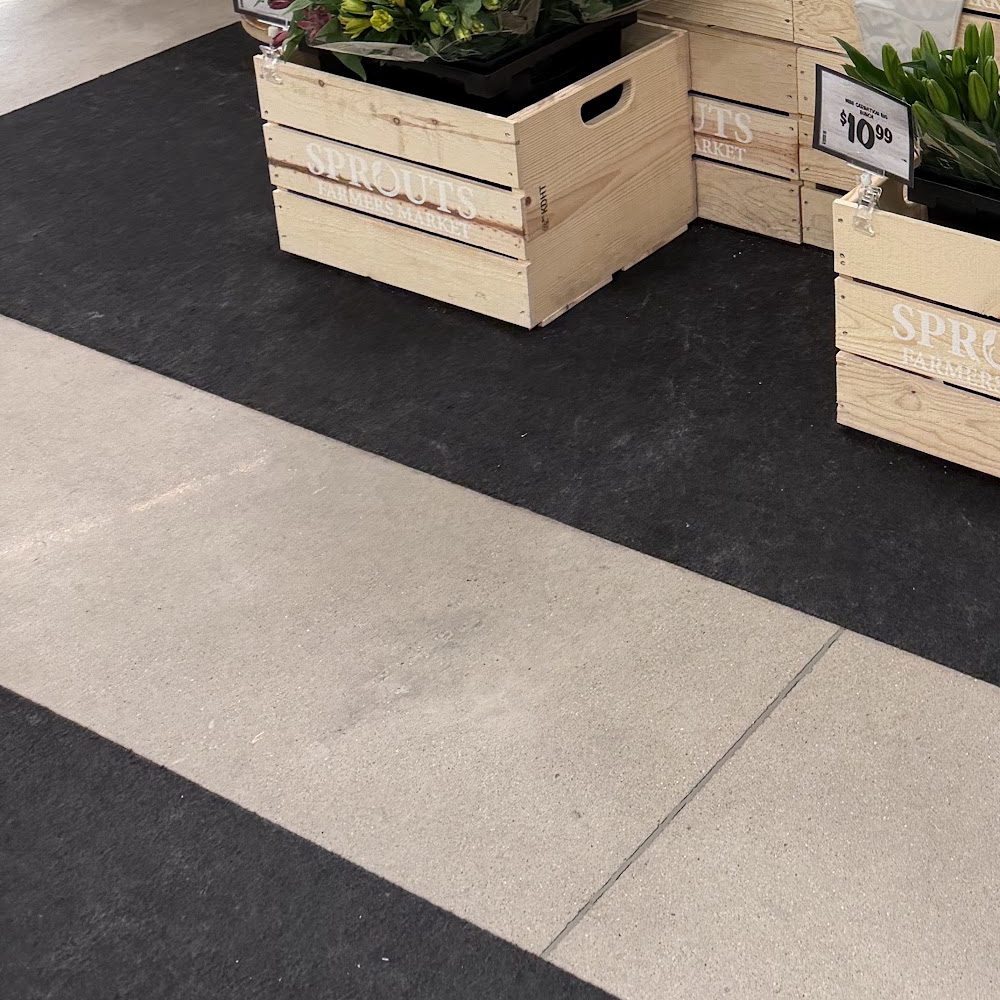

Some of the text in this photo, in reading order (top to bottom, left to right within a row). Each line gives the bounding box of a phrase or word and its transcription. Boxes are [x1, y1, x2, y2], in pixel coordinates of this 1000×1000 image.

[695, 138, 746, 162] RKET
[306, 143, 478, 221] SPROUTS
[317, 180, 471, 240] FARMERS MARKET
